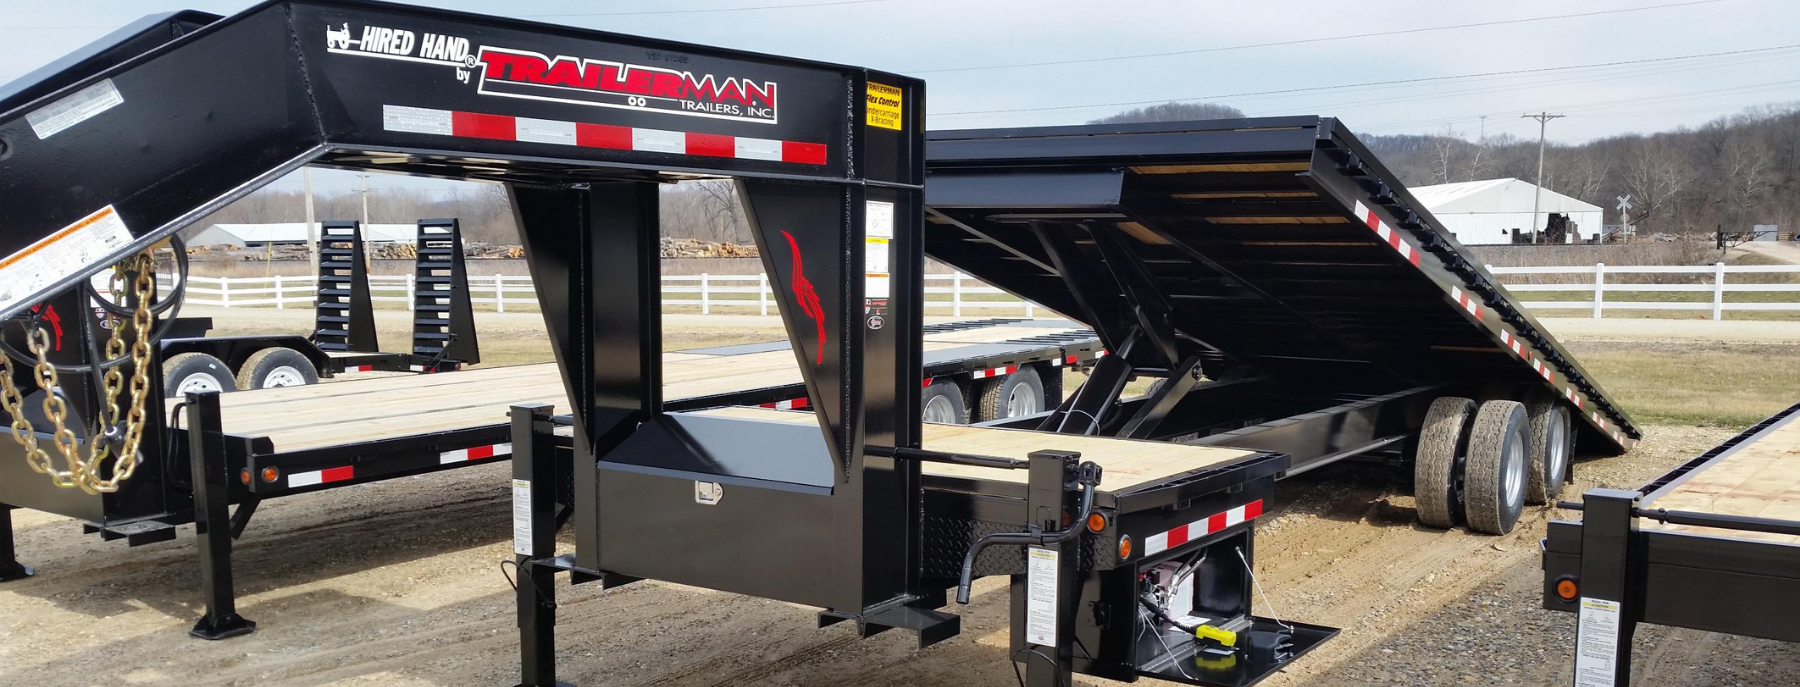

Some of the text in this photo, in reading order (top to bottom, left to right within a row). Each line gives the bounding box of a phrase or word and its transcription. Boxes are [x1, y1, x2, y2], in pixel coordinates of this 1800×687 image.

[359, 25, 470, 62] HIRED HAND
[456, 67, 471, 84] by
[480, 50, 775, 110] TRAILERMAN
[679, 99, 776, 119] TRAILERS, INC.
[878, 96, 900, 108] Control
